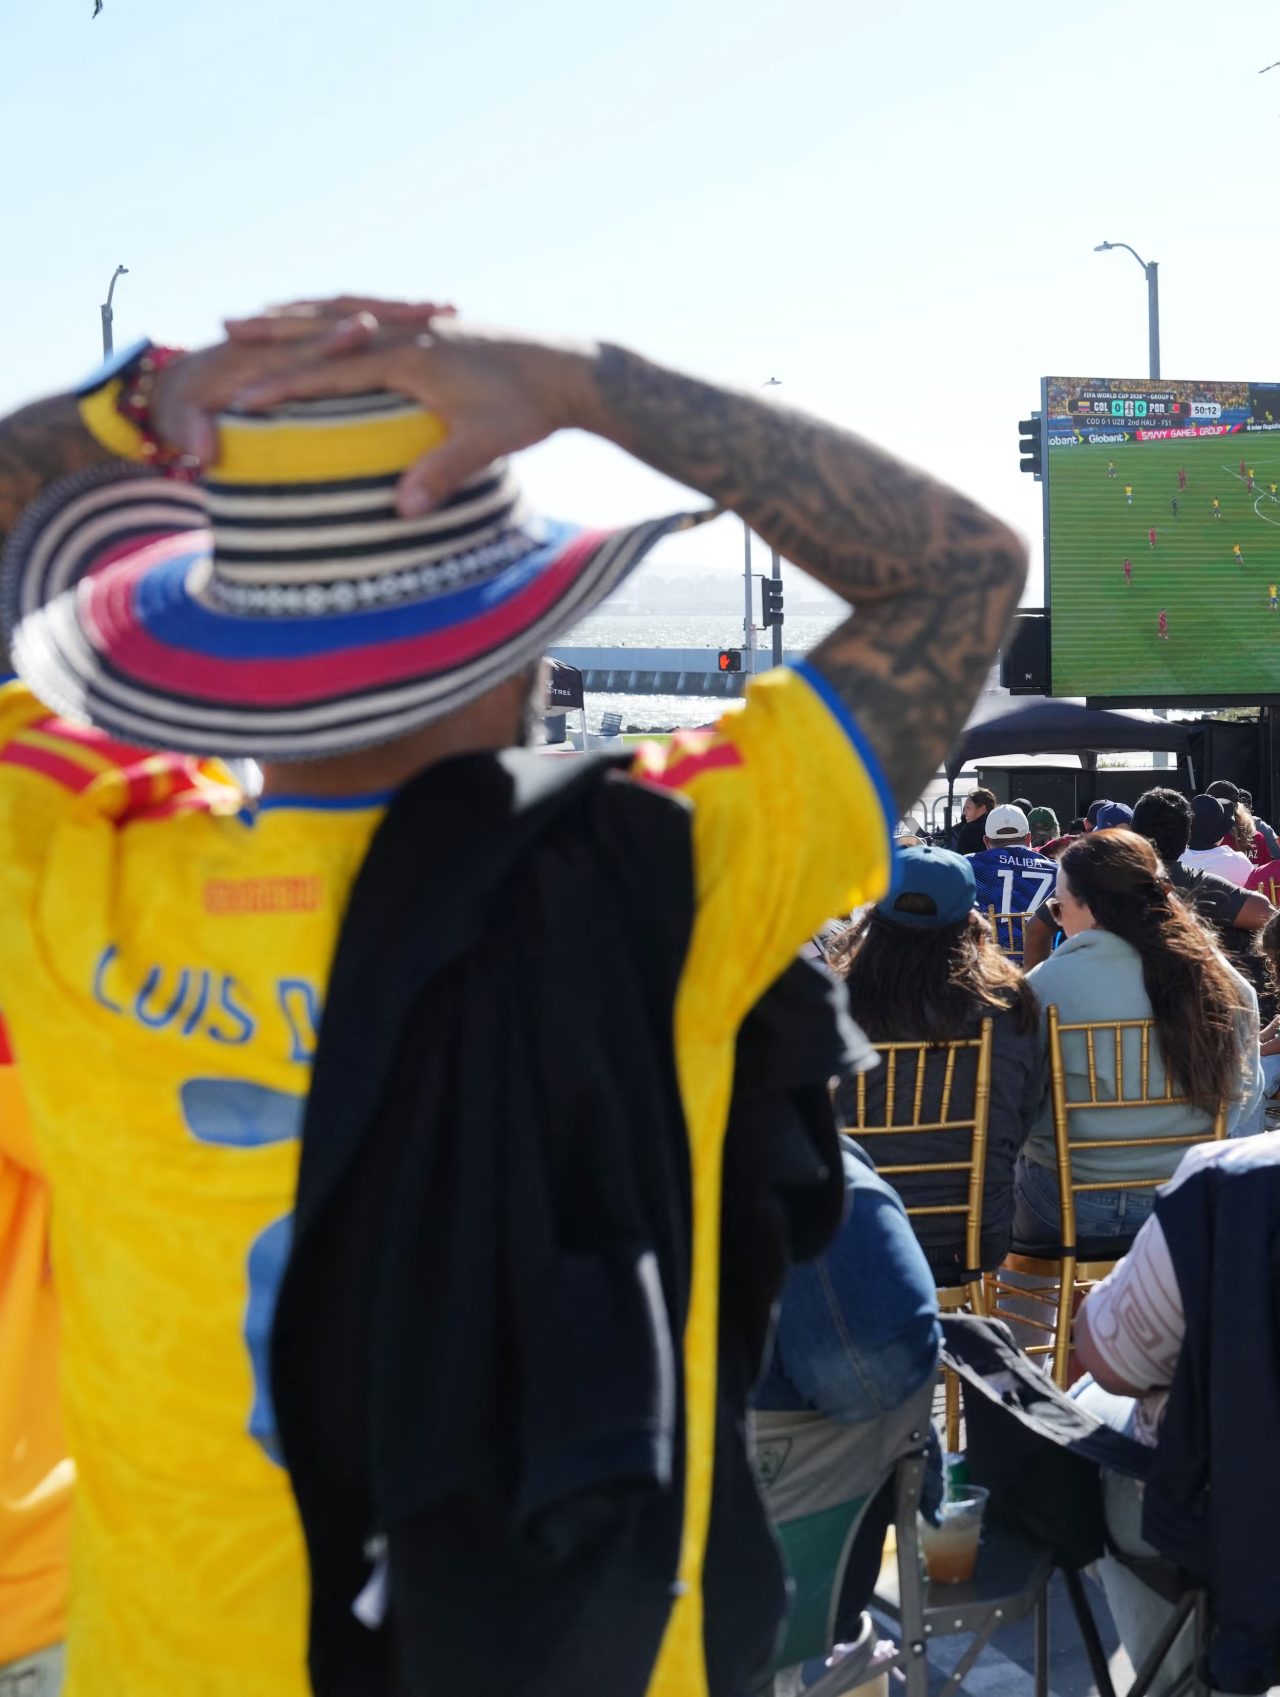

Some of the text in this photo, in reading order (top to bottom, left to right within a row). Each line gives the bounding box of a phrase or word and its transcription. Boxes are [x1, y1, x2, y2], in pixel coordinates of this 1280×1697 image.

[1094, 401, 1217, 415] COL 0 0 POR 50:12
[1089, 434, 1124, 443] Globant
[1141, 427, 1222, 440] SAVVY GAMES GROUP
[999, 855, 1042, 868] SALIBA
[998, 870, 1053, 922] 17
[92, 943, 258, 1046] LUIS
